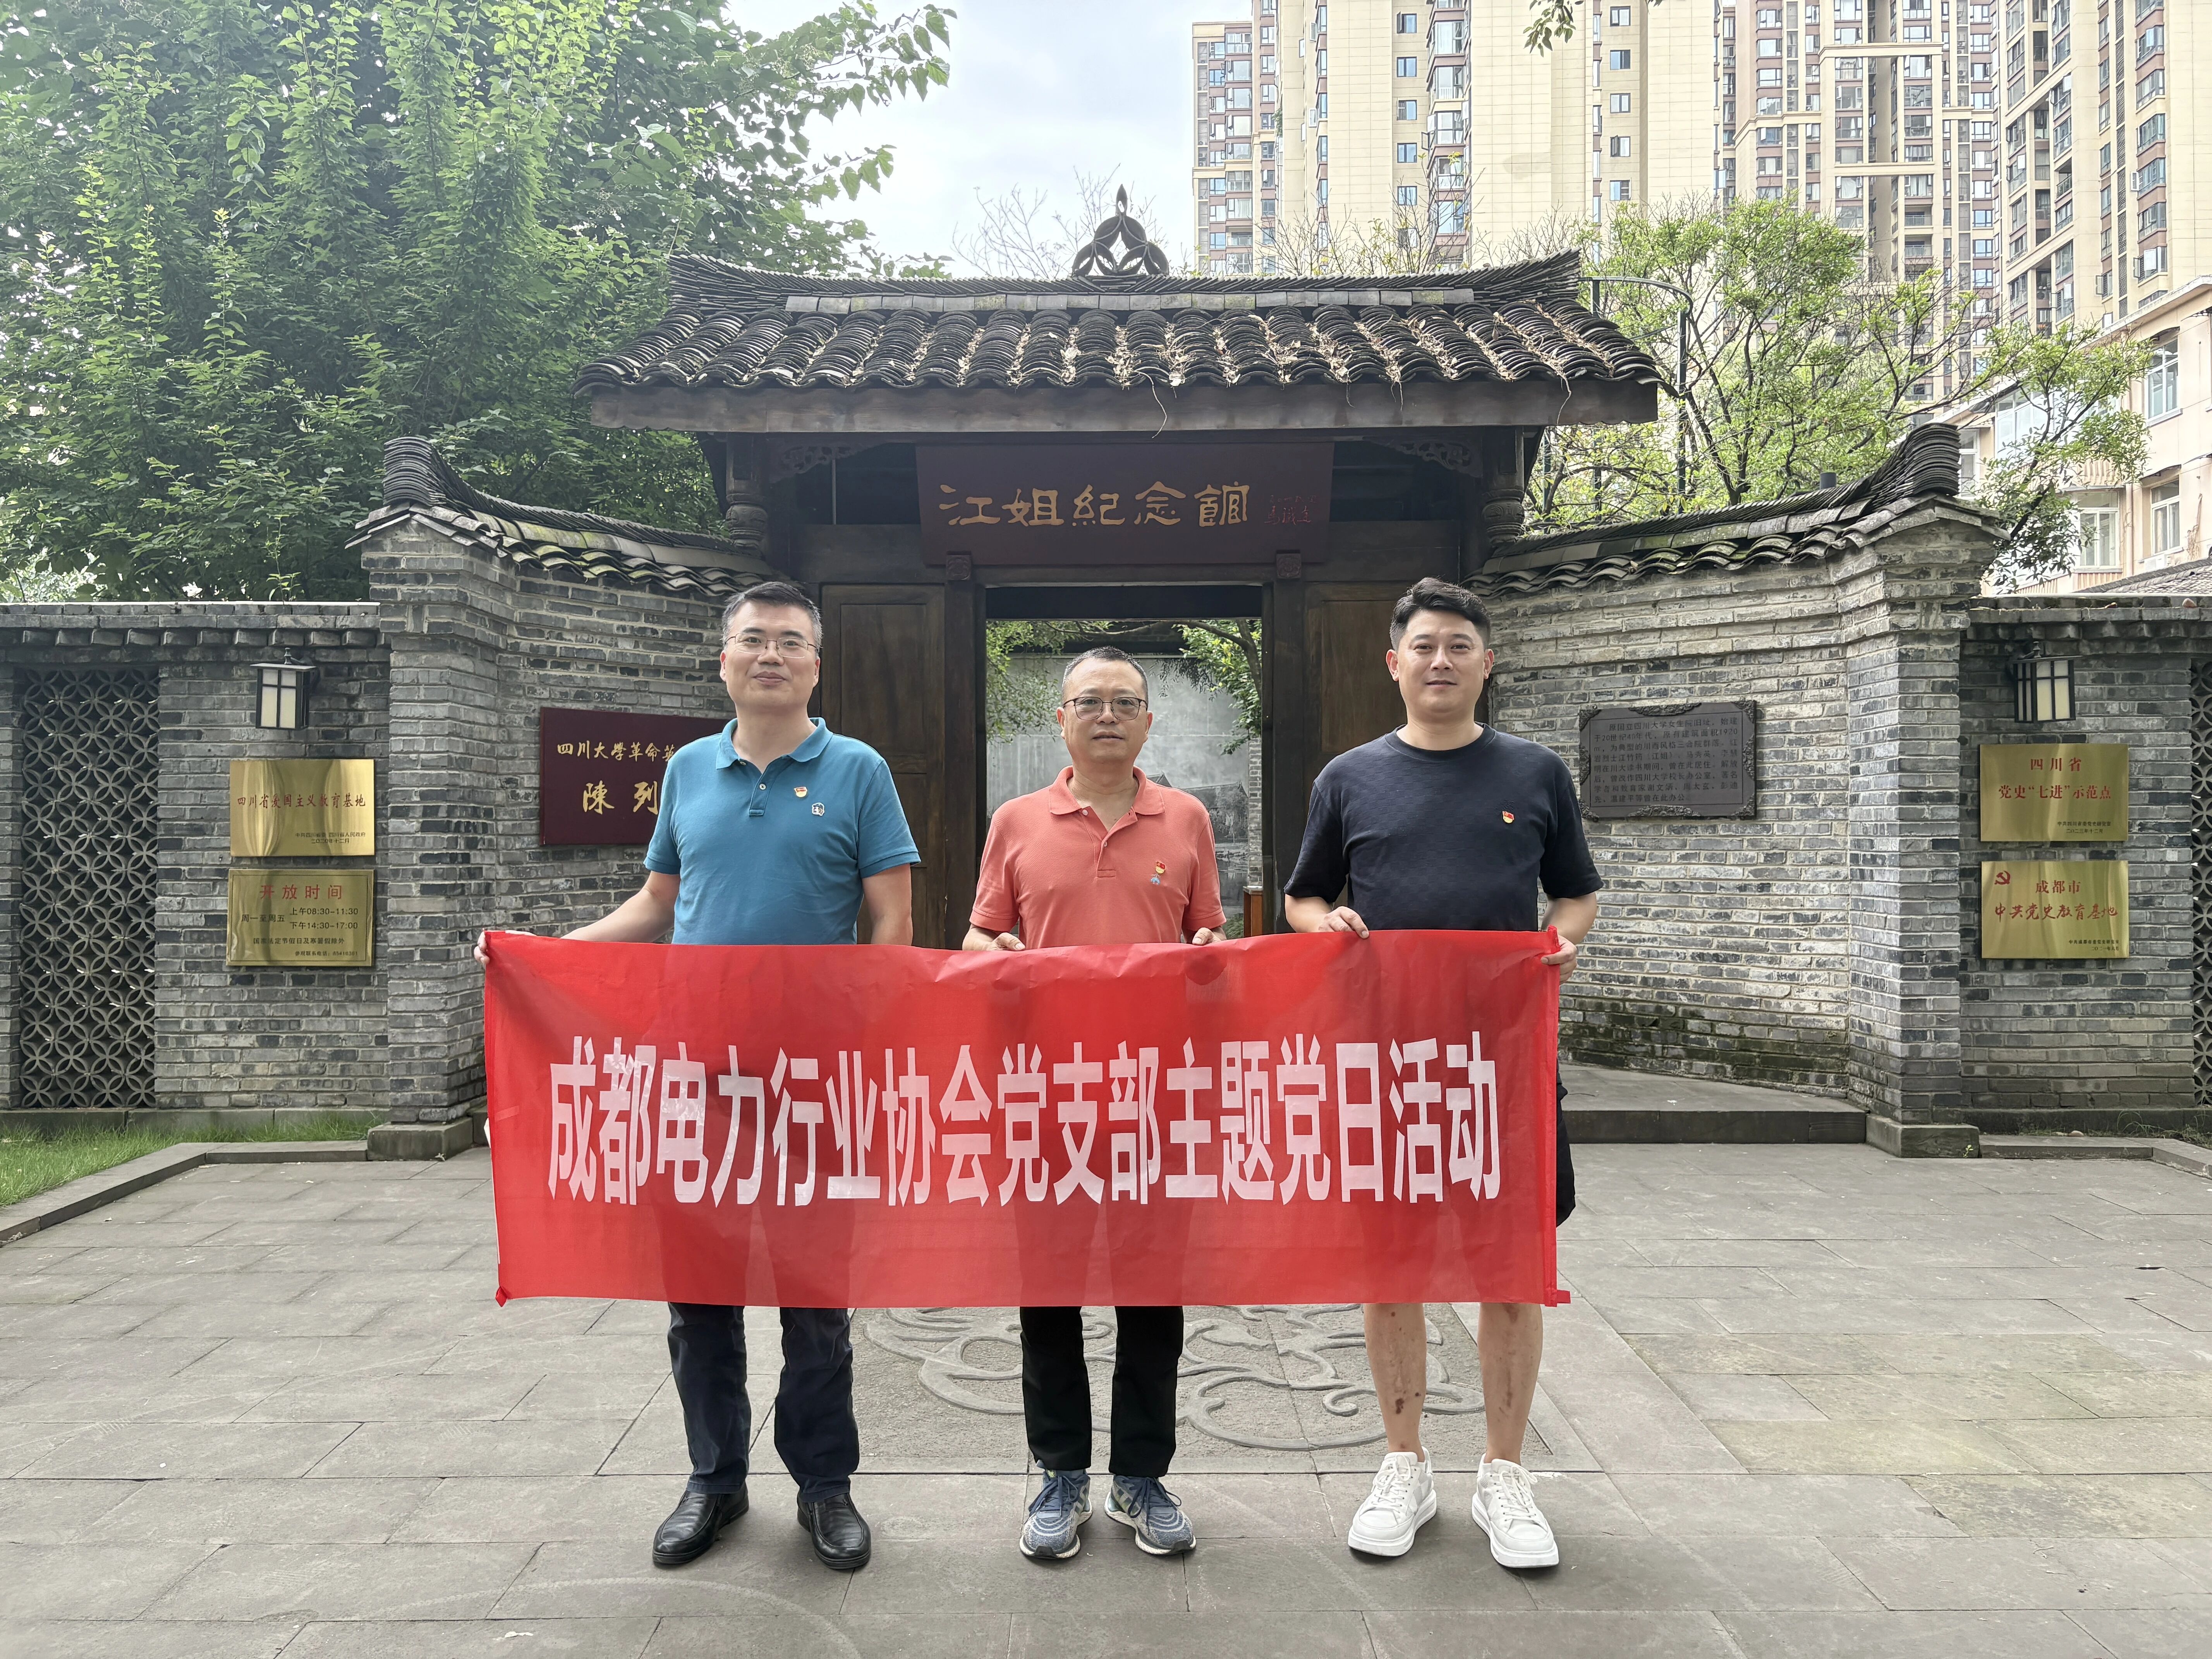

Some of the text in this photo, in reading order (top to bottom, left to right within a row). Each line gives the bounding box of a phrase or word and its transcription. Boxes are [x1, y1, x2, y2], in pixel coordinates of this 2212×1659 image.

[939, 481, 1250, 527] 江姐紀念館
[2030, 757, 2082, 772] 四川省
[237, 793, 366, 809] 四川省爱国主义教育基地
[260, 884, 342, 900] 开放时间
[2035, 880, 2081, 894] 成都市
[241, 914, 285, 922] 周一至周五
[1995, 902, 2118, 922] 中共党史教育基地
[548, 1030, 1501, 1208] 成都电力行业协会党支部主题党日活动
